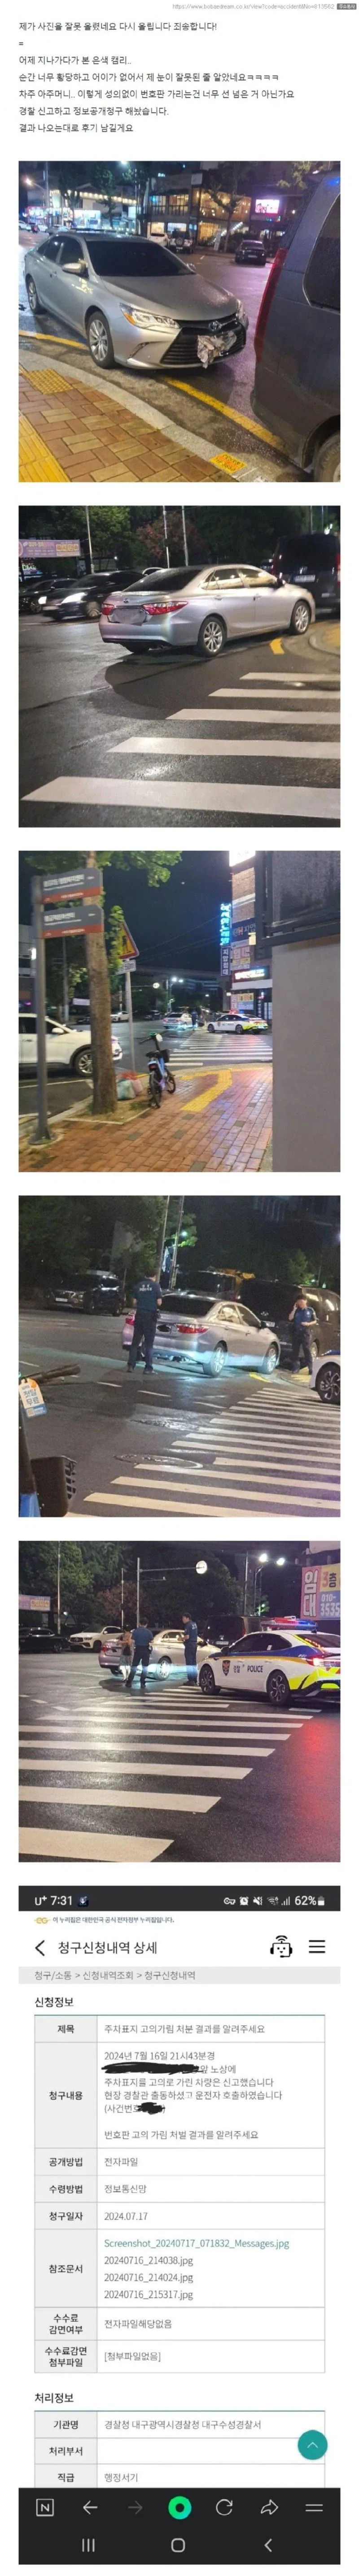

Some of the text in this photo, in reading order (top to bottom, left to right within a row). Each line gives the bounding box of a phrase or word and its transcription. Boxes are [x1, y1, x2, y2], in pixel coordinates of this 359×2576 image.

[322, 1572, 337, 1588] 3층
[303, 1569, 318, 1617] 임대
[50, 1895, 72, 1906] 7:31
[295, 1895, 317, 1906] 62%
[58, 1941, 157, 1954] 청구신청내역 상세
[35, 1971, 71, 1981] 청구/소통
[83, 1971, 133, 1980] 신청내역조회
[145, 1971, 195, 1980] 청구신청내역
[35, 1997, 74, 2008] 신청정보
[57, 2025, 74, 2034] 제목
[105, 2025, 265, 2034] 주차표지 고의가림 처분 결과를 알려주세요
[104, 2051, 215, 2060] 2024년 7월 16일 21시43분경
[210, 2065, 236, 2074] 노상에
[105, 2078, 274, 2087] 주차표지를 고의로 가린 차량은 신고했습니다
[49, 2091, 83, 2100] 청구내용
[105, 2090, 282, 2100] 현장 경찰관 출동하셨고 운전자 호출하였습니다
[105, 2130, 258, 2140] 번호판 고의 가림 처벌 결과를 알려주세요
[49, 2157, 83, 2167] 공개방법
[105, 2157, 138, 2167] 전자파일
[49, 2185, 83, 2194] 수령방법
[105, 2185, 147, 2194] 정보통신망
[49, 2212, 83, 2221] 청구일자
[104, 2212, 148, 2220] 2024.07.17
[105, 2239, 289, 2250] Screenshot_20240717_071832_Messages.jpg
[104, 2256, 193, 2267] 20240716_214038.jpg
[49, 2264, 83, 2273] 참조문서
[104, 2273, 193, 2284] 20240716_214024.jpg
[104, 2290, 193, 2301] 20240716_215317.jpg
[53, 2313, 79, 2323] 수수료
[105, 2320, 171, 2329] 전자파일해당없음
[49, 2325, 83, 2335] 감면여부
[44, 2346, 87, 2356] 수수료감면
[105, 2352, 161, 2362] [첨부파일없음]
[49, 2358, 83, 2367] 첨부파일
[35, 2393, 74, 2404] 처리정보
[53, 2420, 78, 2429] 기관명
[105, 2420, 261, 2429] 경찰청 대구광역시경찰청 대구수성경찰서
[49, 2446, 83, 2456] 처리부서
[57, 2473, 74, 2483] 직급
[104, 2473, 138, 2482] 행정서기
